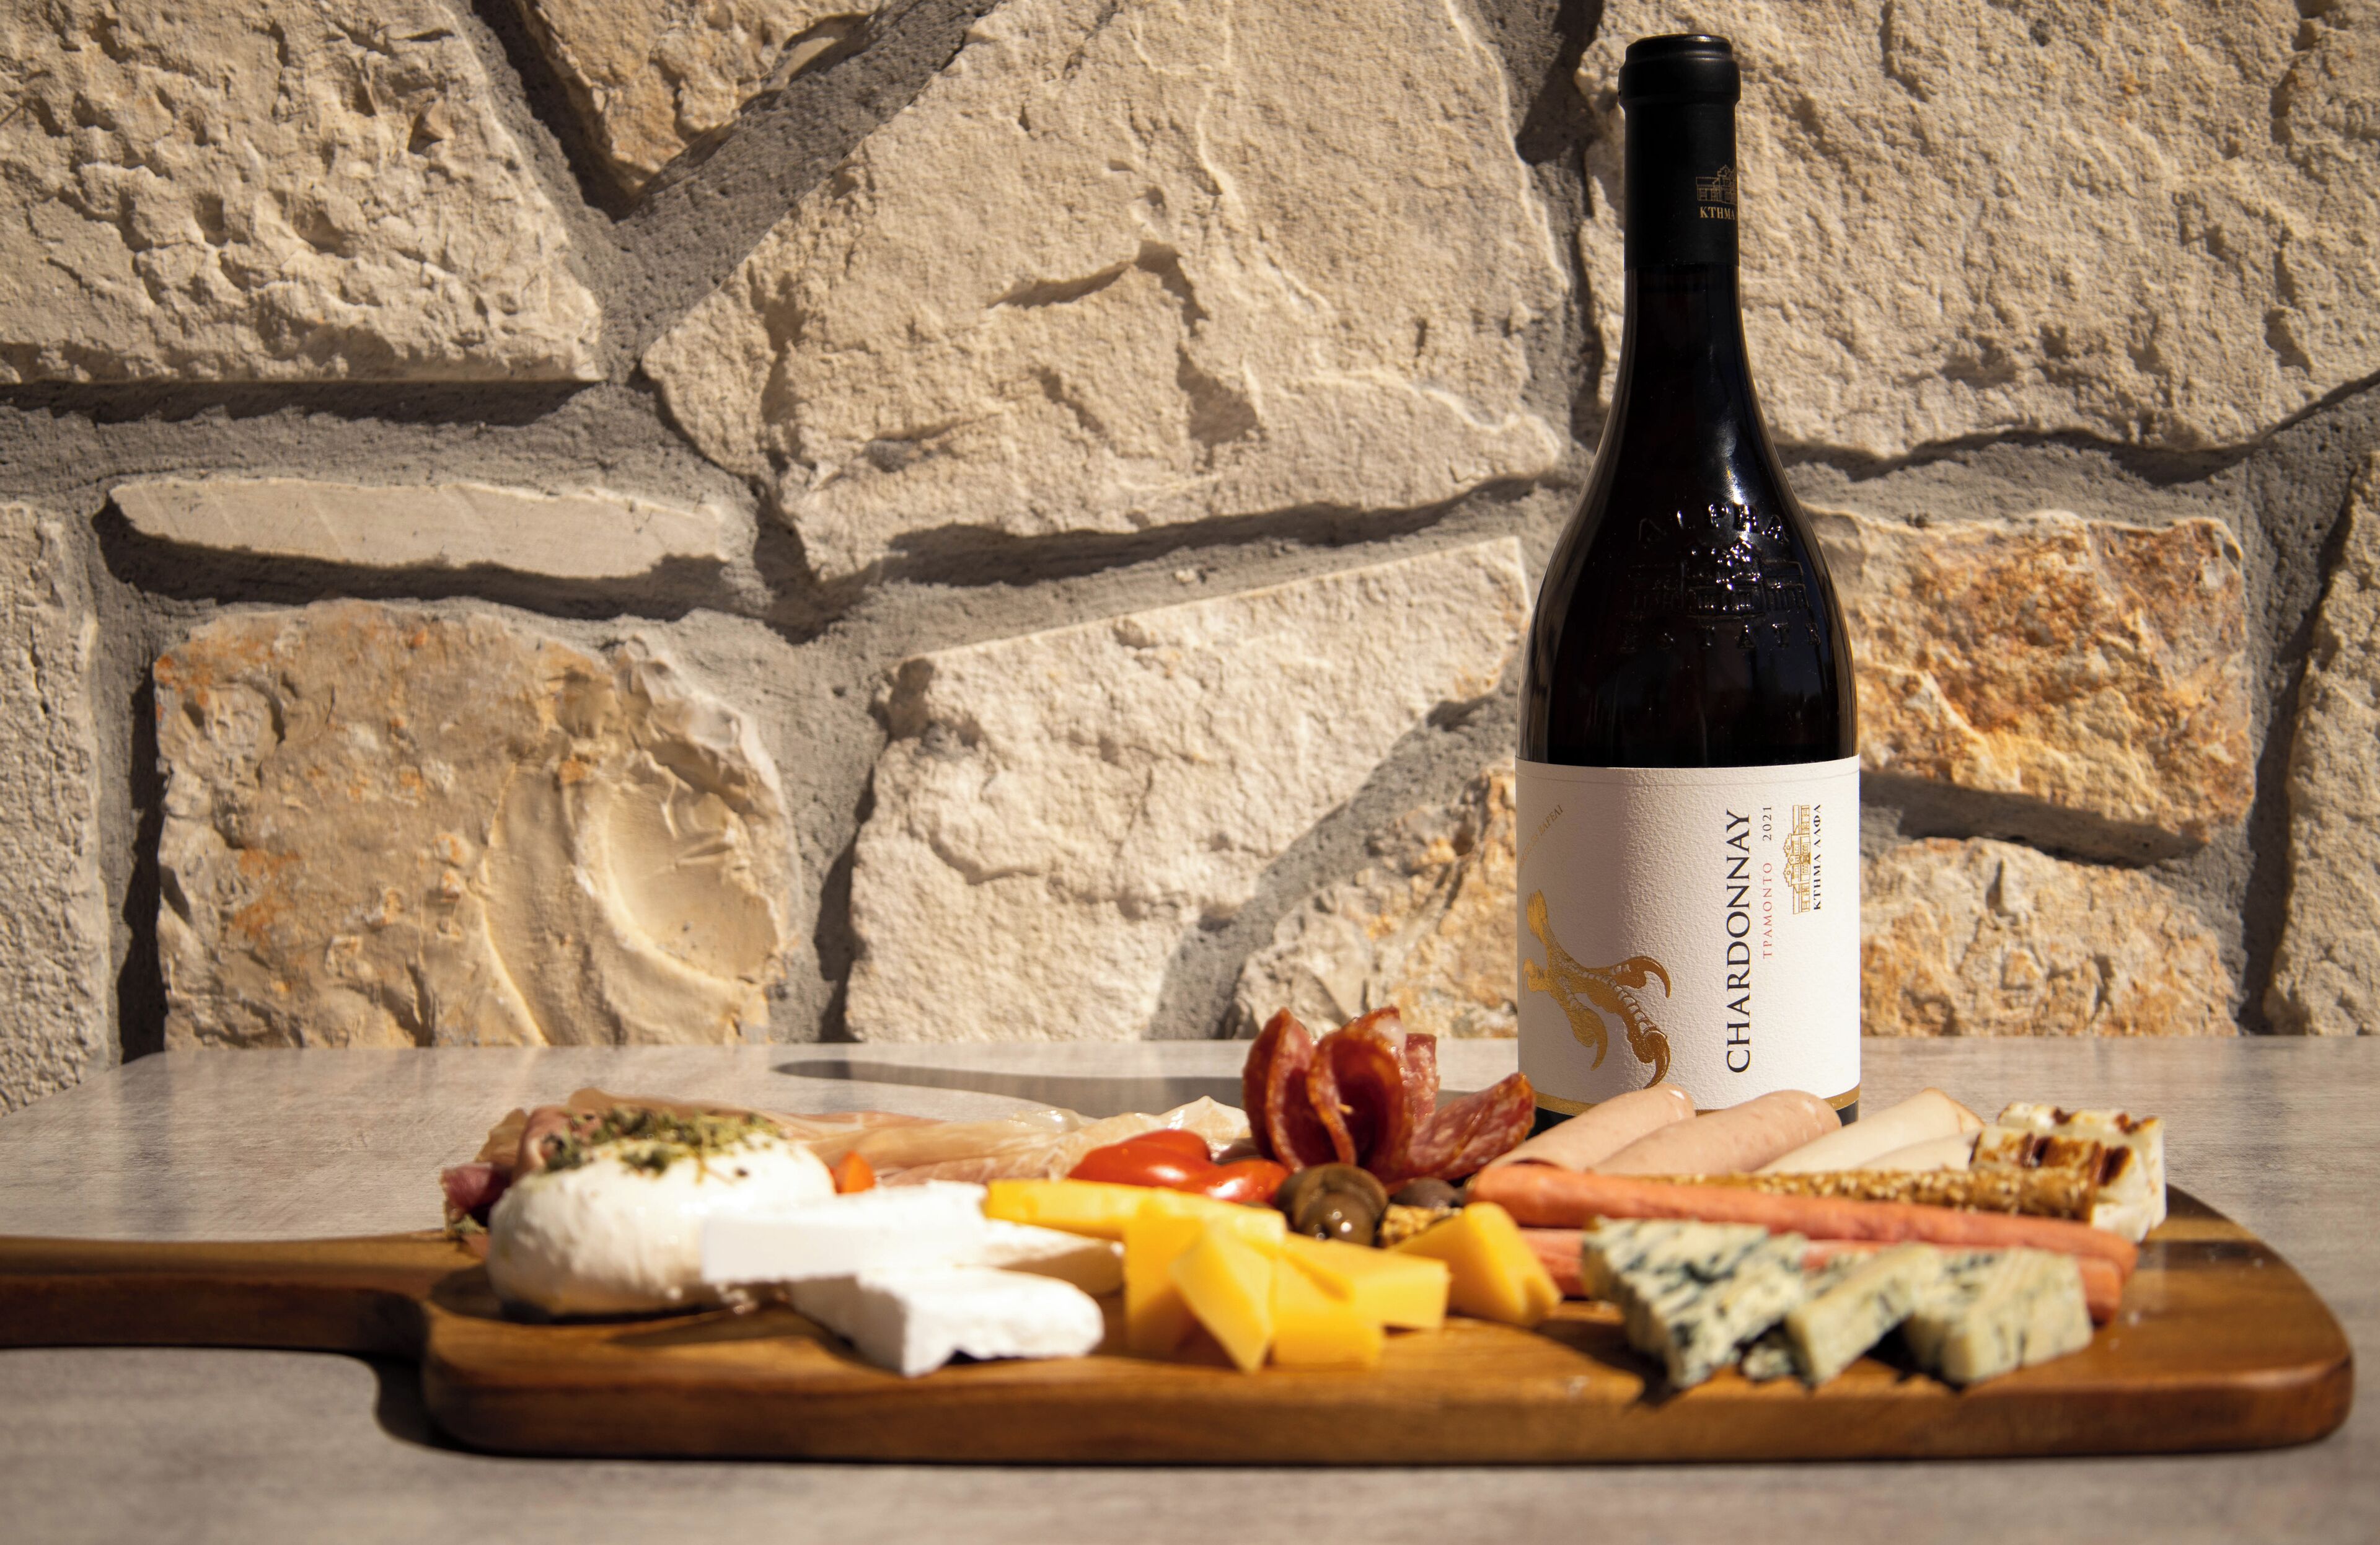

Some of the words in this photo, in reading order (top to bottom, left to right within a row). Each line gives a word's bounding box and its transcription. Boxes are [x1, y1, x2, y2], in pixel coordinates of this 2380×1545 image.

[1762, 806, 1773, 841] 2021
[1726, 809, 1751, 1074] CHARDONNAY
[1763, 862, 1773, 959] ΤΡΑΜΟΝΤΟ
